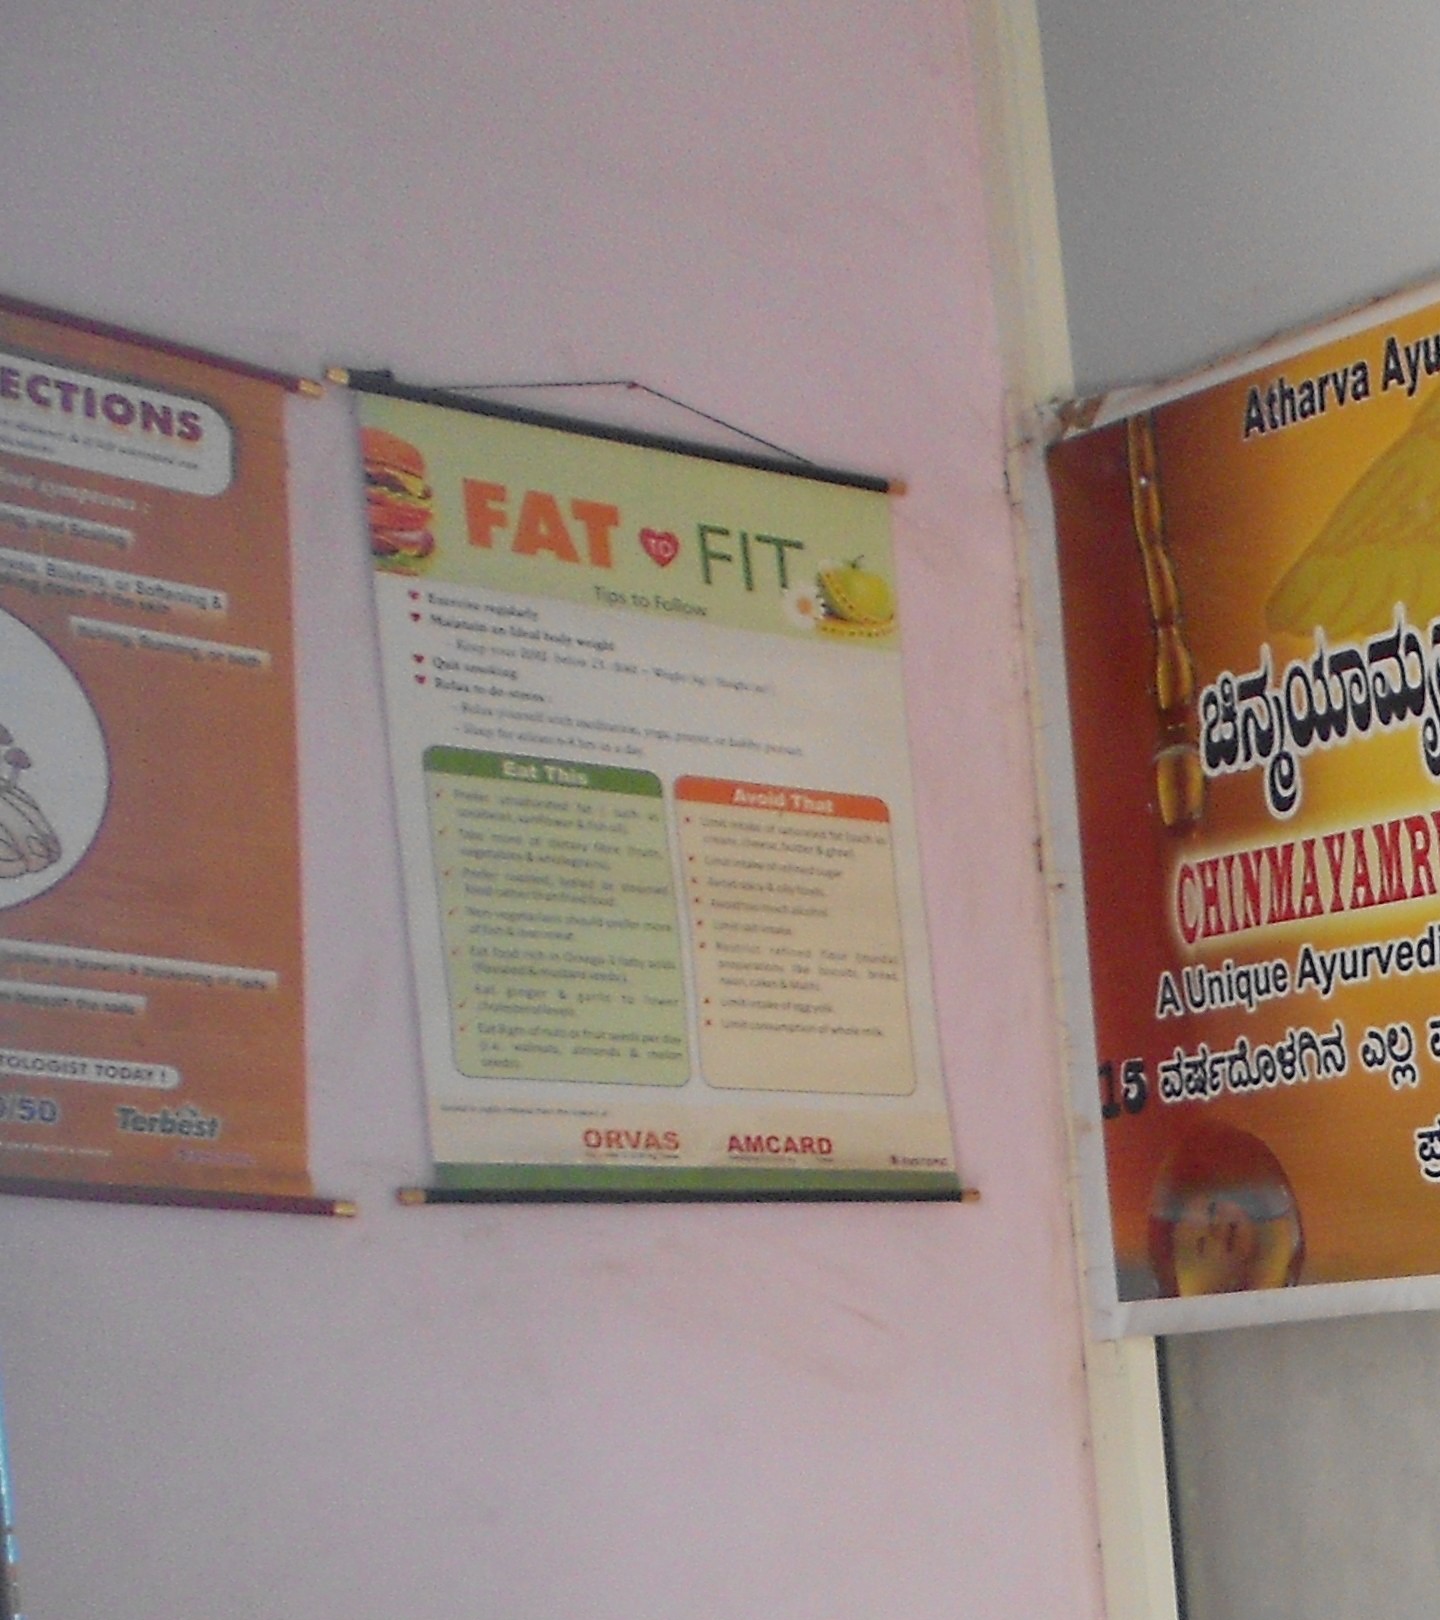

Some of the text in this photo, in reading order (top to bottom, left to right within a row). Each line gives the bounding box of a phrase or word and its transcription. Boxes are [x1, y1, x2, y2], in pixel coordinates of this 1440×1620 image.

[0, 366, 203, 442] ECTIONS
[1244, 359, 1370, 438] Atharva
[462, 477, 620, 569] FAT
[697, 523, 804, 592] FIT
[654, 594, 707, 617] Follow
[503, 759, 588, 785] Eat This
[732, 787, 834, 813] Avoid That
[1157, 974, 1182, 1016] A
[1185, 960, 1288, 1009] Unique
[96, 1064, 153, 1081] TODAY
[1100, 1058, 1147, 1118] 15
[1362, 1023, 1417, 1086] ಎಲ್ಲ
[582, 1127, 834, 1157] ORVAS AMCARD
